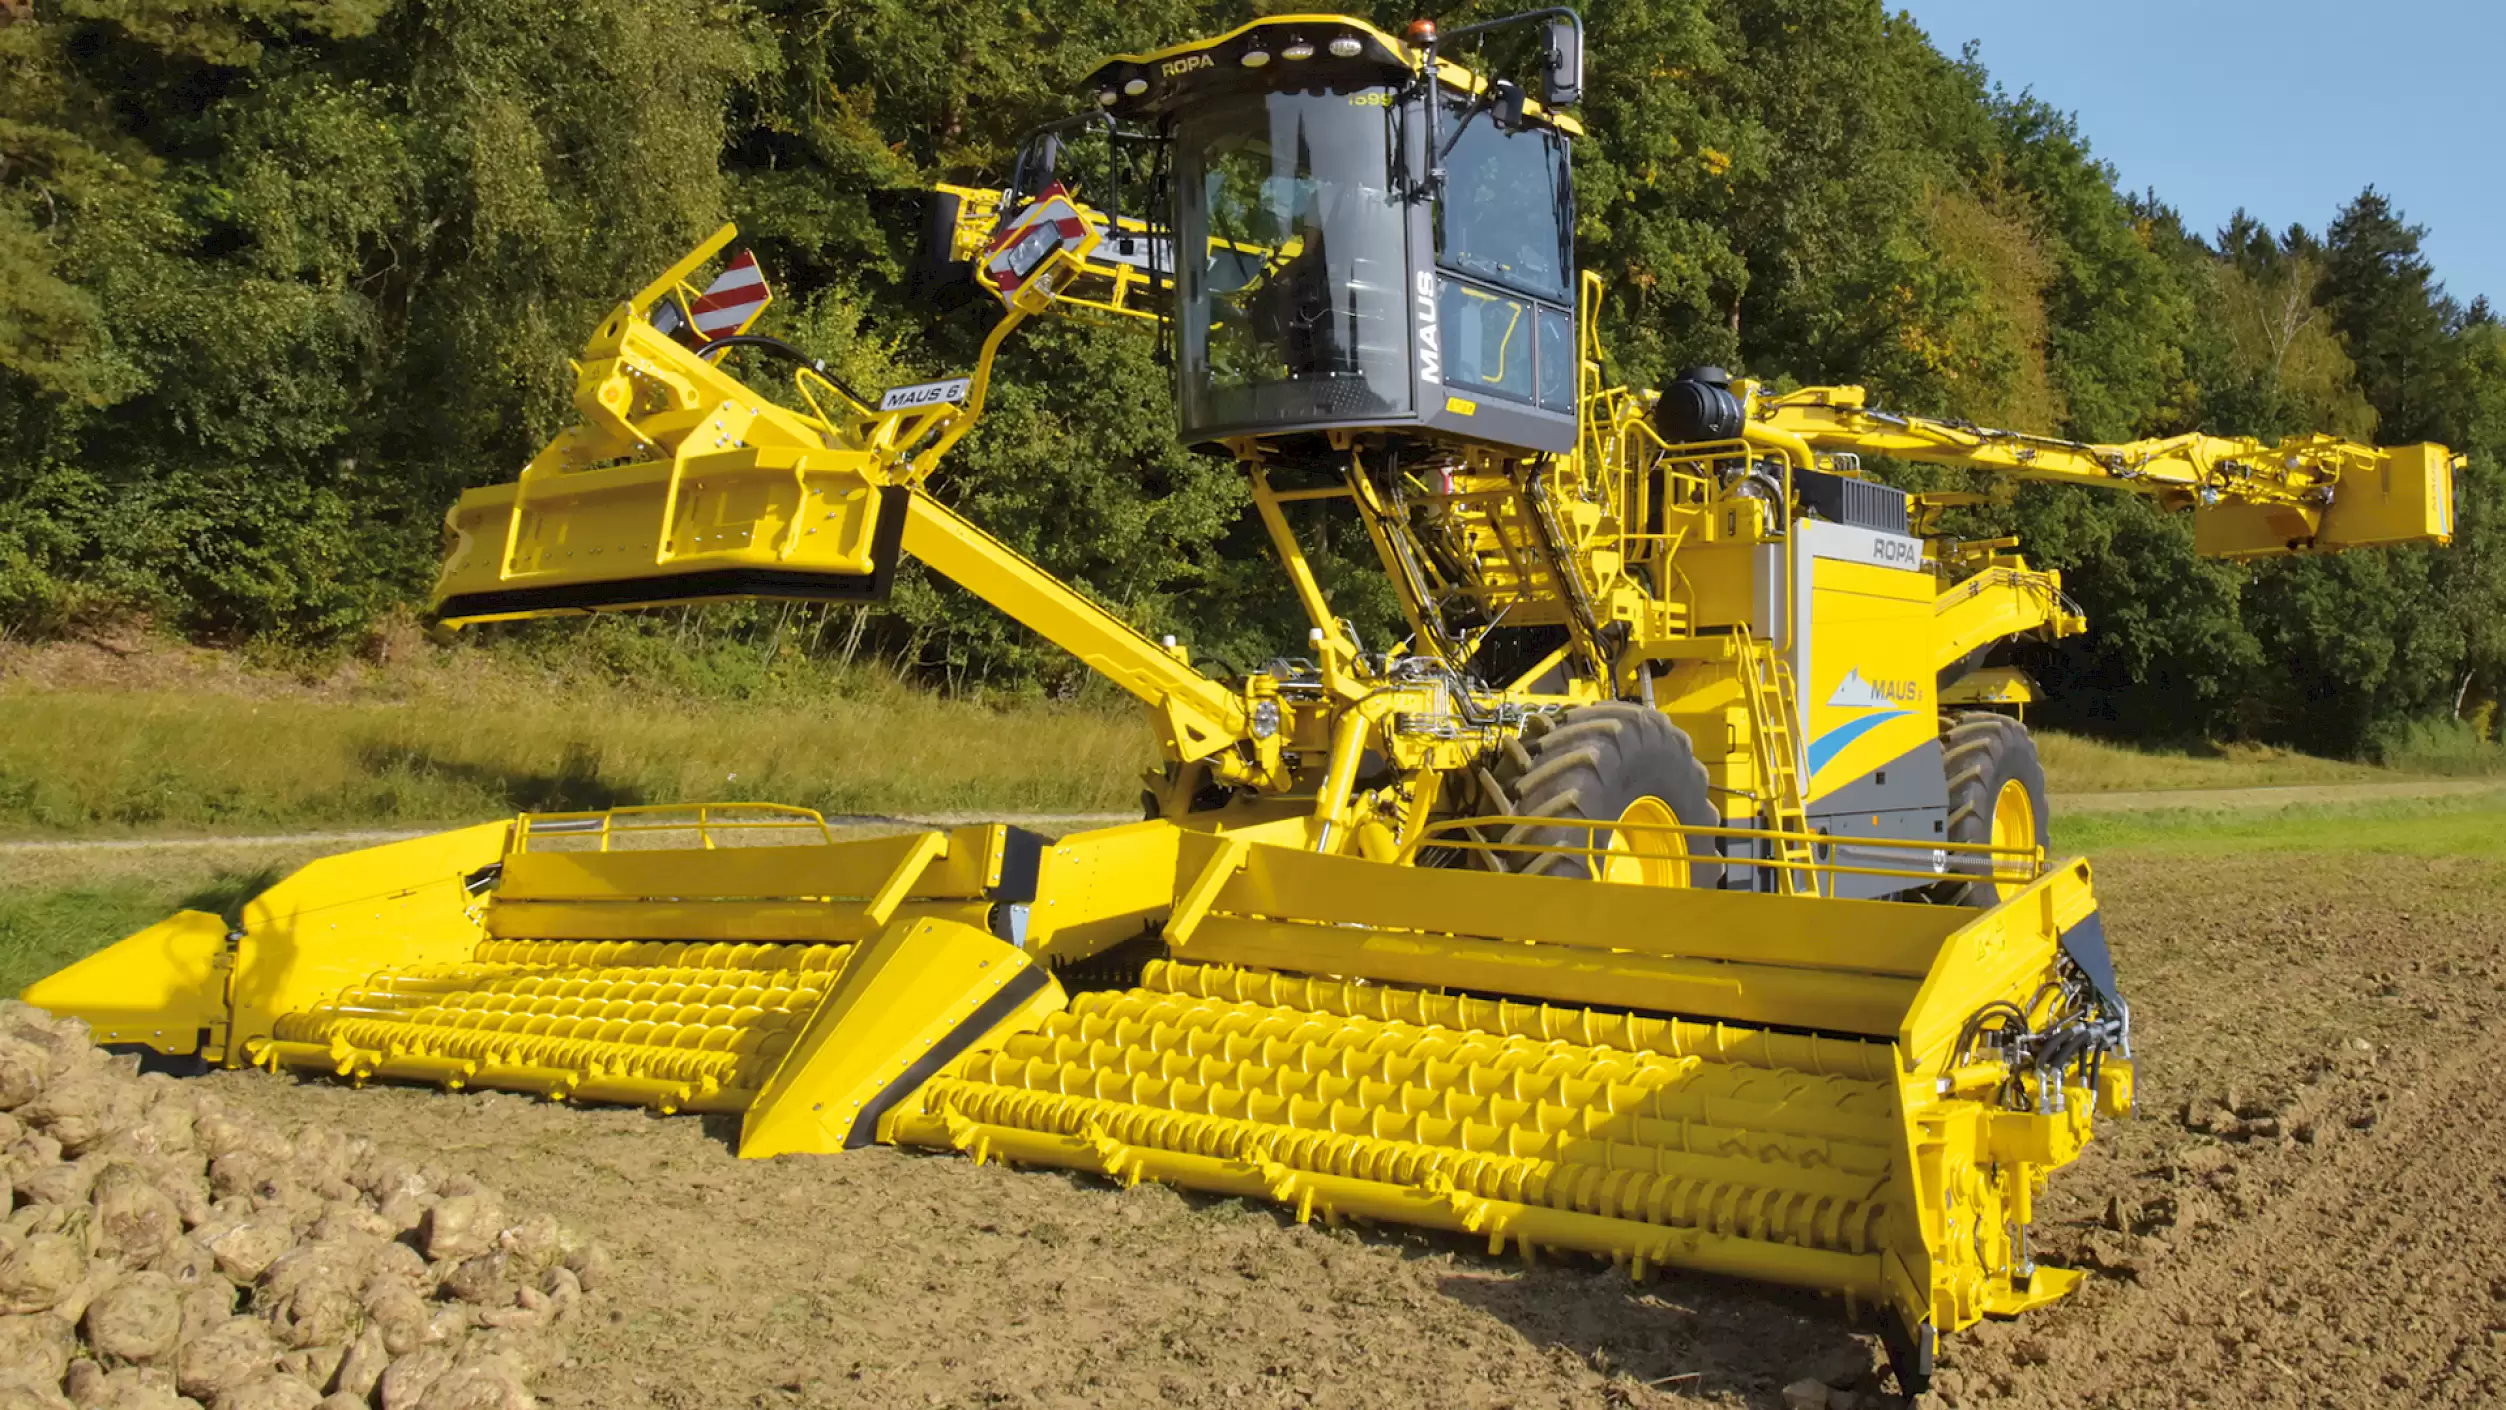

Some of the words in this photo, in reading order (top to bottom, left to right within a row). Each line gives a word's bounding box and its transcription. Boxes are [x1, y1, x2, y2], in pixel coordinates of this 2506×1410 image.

[1161, 54, 1215, 78] ROPA
[1417, 270, 1440, 385] MAUS
[887, 388, 942, 407] MAUS
[946, 384, 960, 398] 6
[1873, 538, 1916, 565] ROPA
[1871, 679, 1916, 701] MAUS
